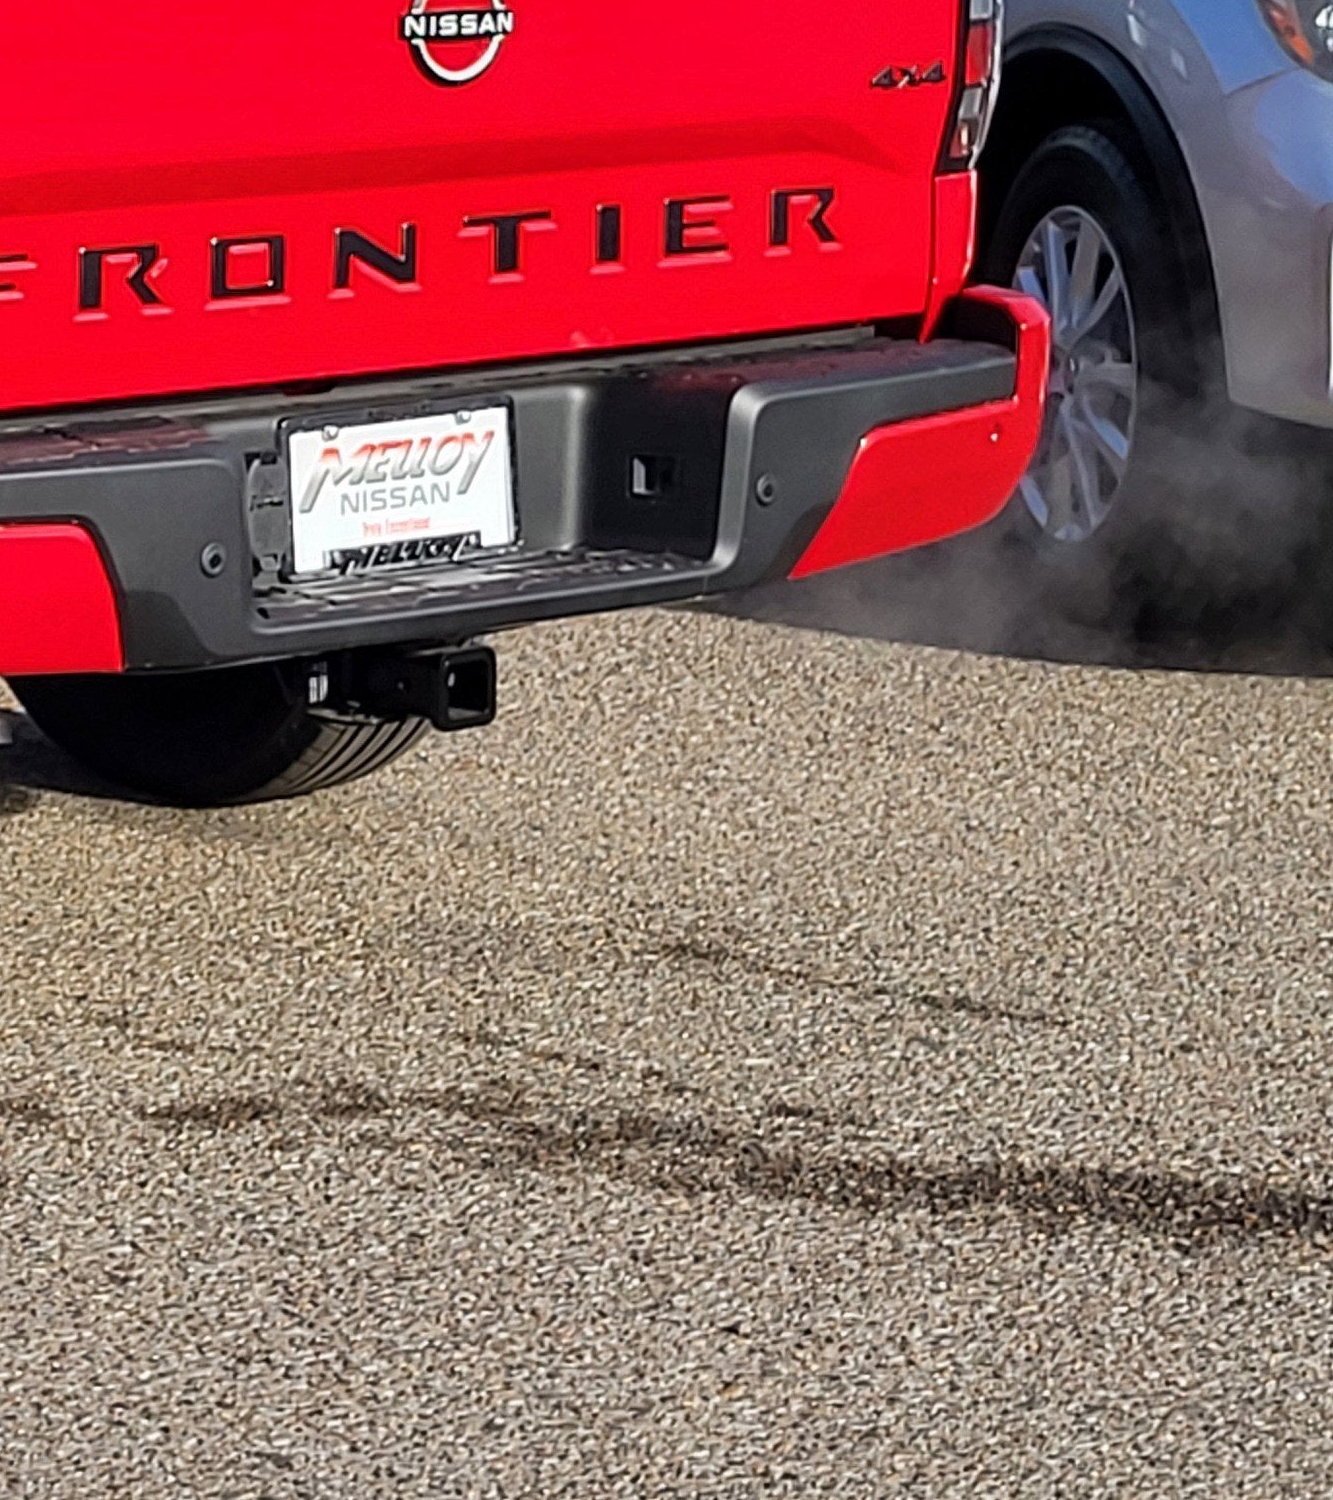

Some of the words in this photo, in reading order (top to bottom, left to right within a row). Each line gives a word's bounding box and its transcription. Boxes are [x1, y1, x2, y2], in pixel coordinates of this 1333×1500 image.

[403, 11, 514, 38] NISSAN
[298, 430, 495, 514] MELLOY
[340, 481, 451, 516] NISSAN
